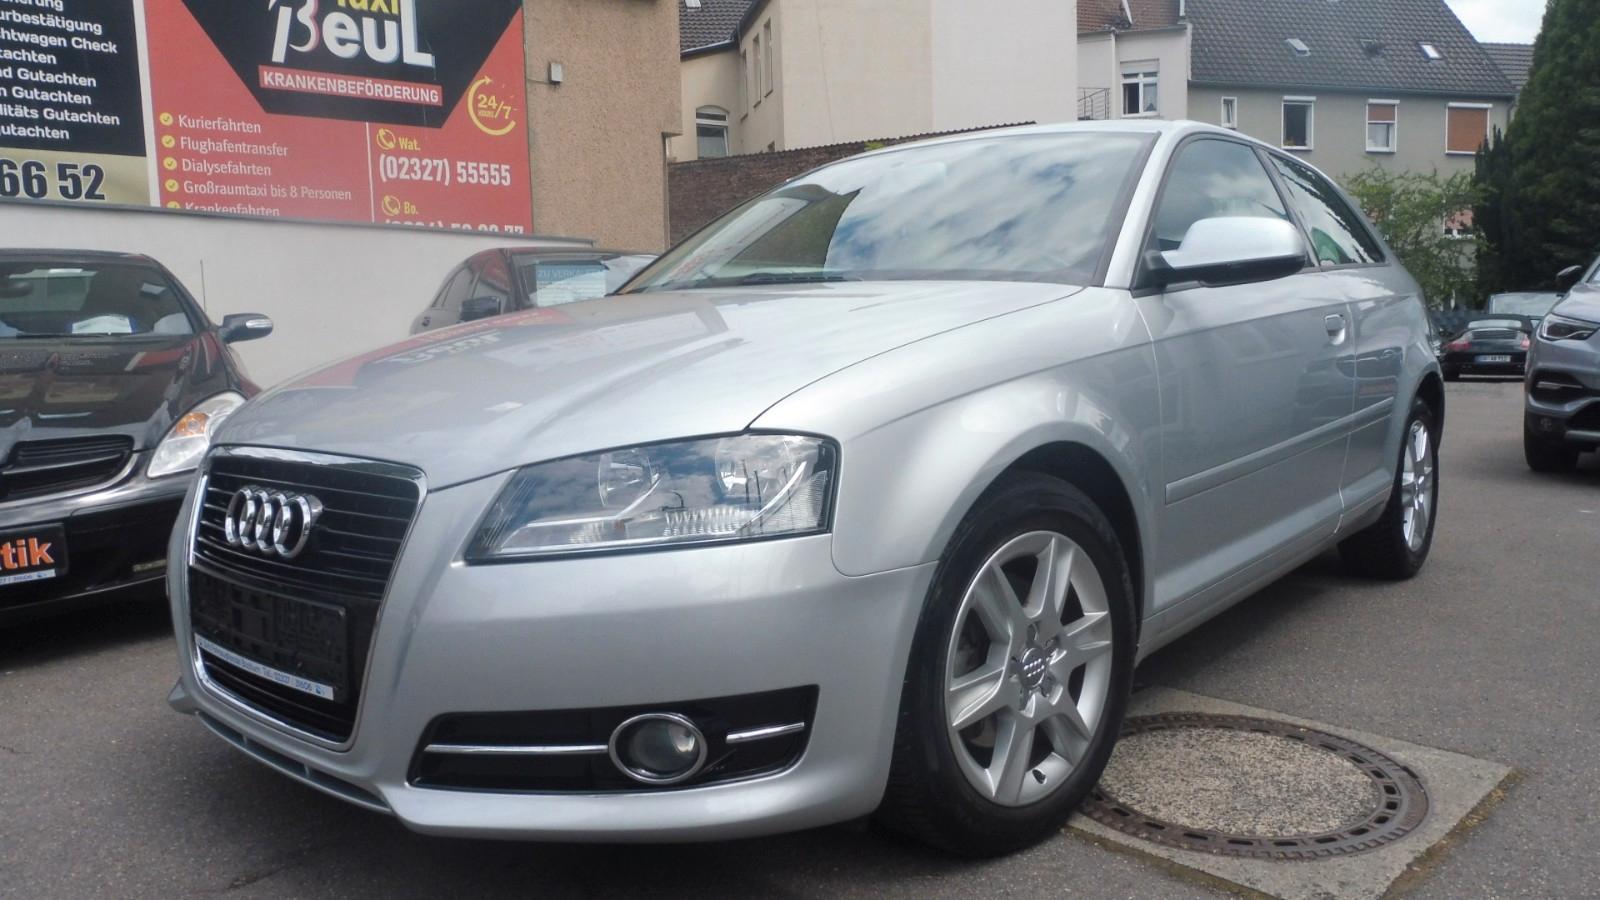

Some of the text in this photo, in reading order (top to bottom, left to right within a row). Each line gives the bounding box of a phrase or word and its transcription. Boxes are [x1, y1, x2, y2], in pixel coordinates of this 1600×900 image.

[0, 28, 118, 53] htwagen Check
[17, 68, 97, 87] Gutachten
[263, 71, 439, 103] KRANKENBEFÖRDERUNG
[12, 86, 92, 105] Gutachten
[478, 94, 511, 119] 24/7
[43, 108, 120, 125] Gutachten
[178, 115, 261, 133] Kurierfahrten
[0, 123, 70, 139] utachten
[180, 137, 288, 156] Flughafentransfer
[399, 137, 421, 150] Wat.
[182, 159, 271, 176] Dialysefahrten
[380, 153, 511, 186] (02327) 55555
[57, 162, 106, 200] 52
[184, 181, 351, 200] Großraumtaxi bis 8 Personen
[0, 537, 55, 569] tik
